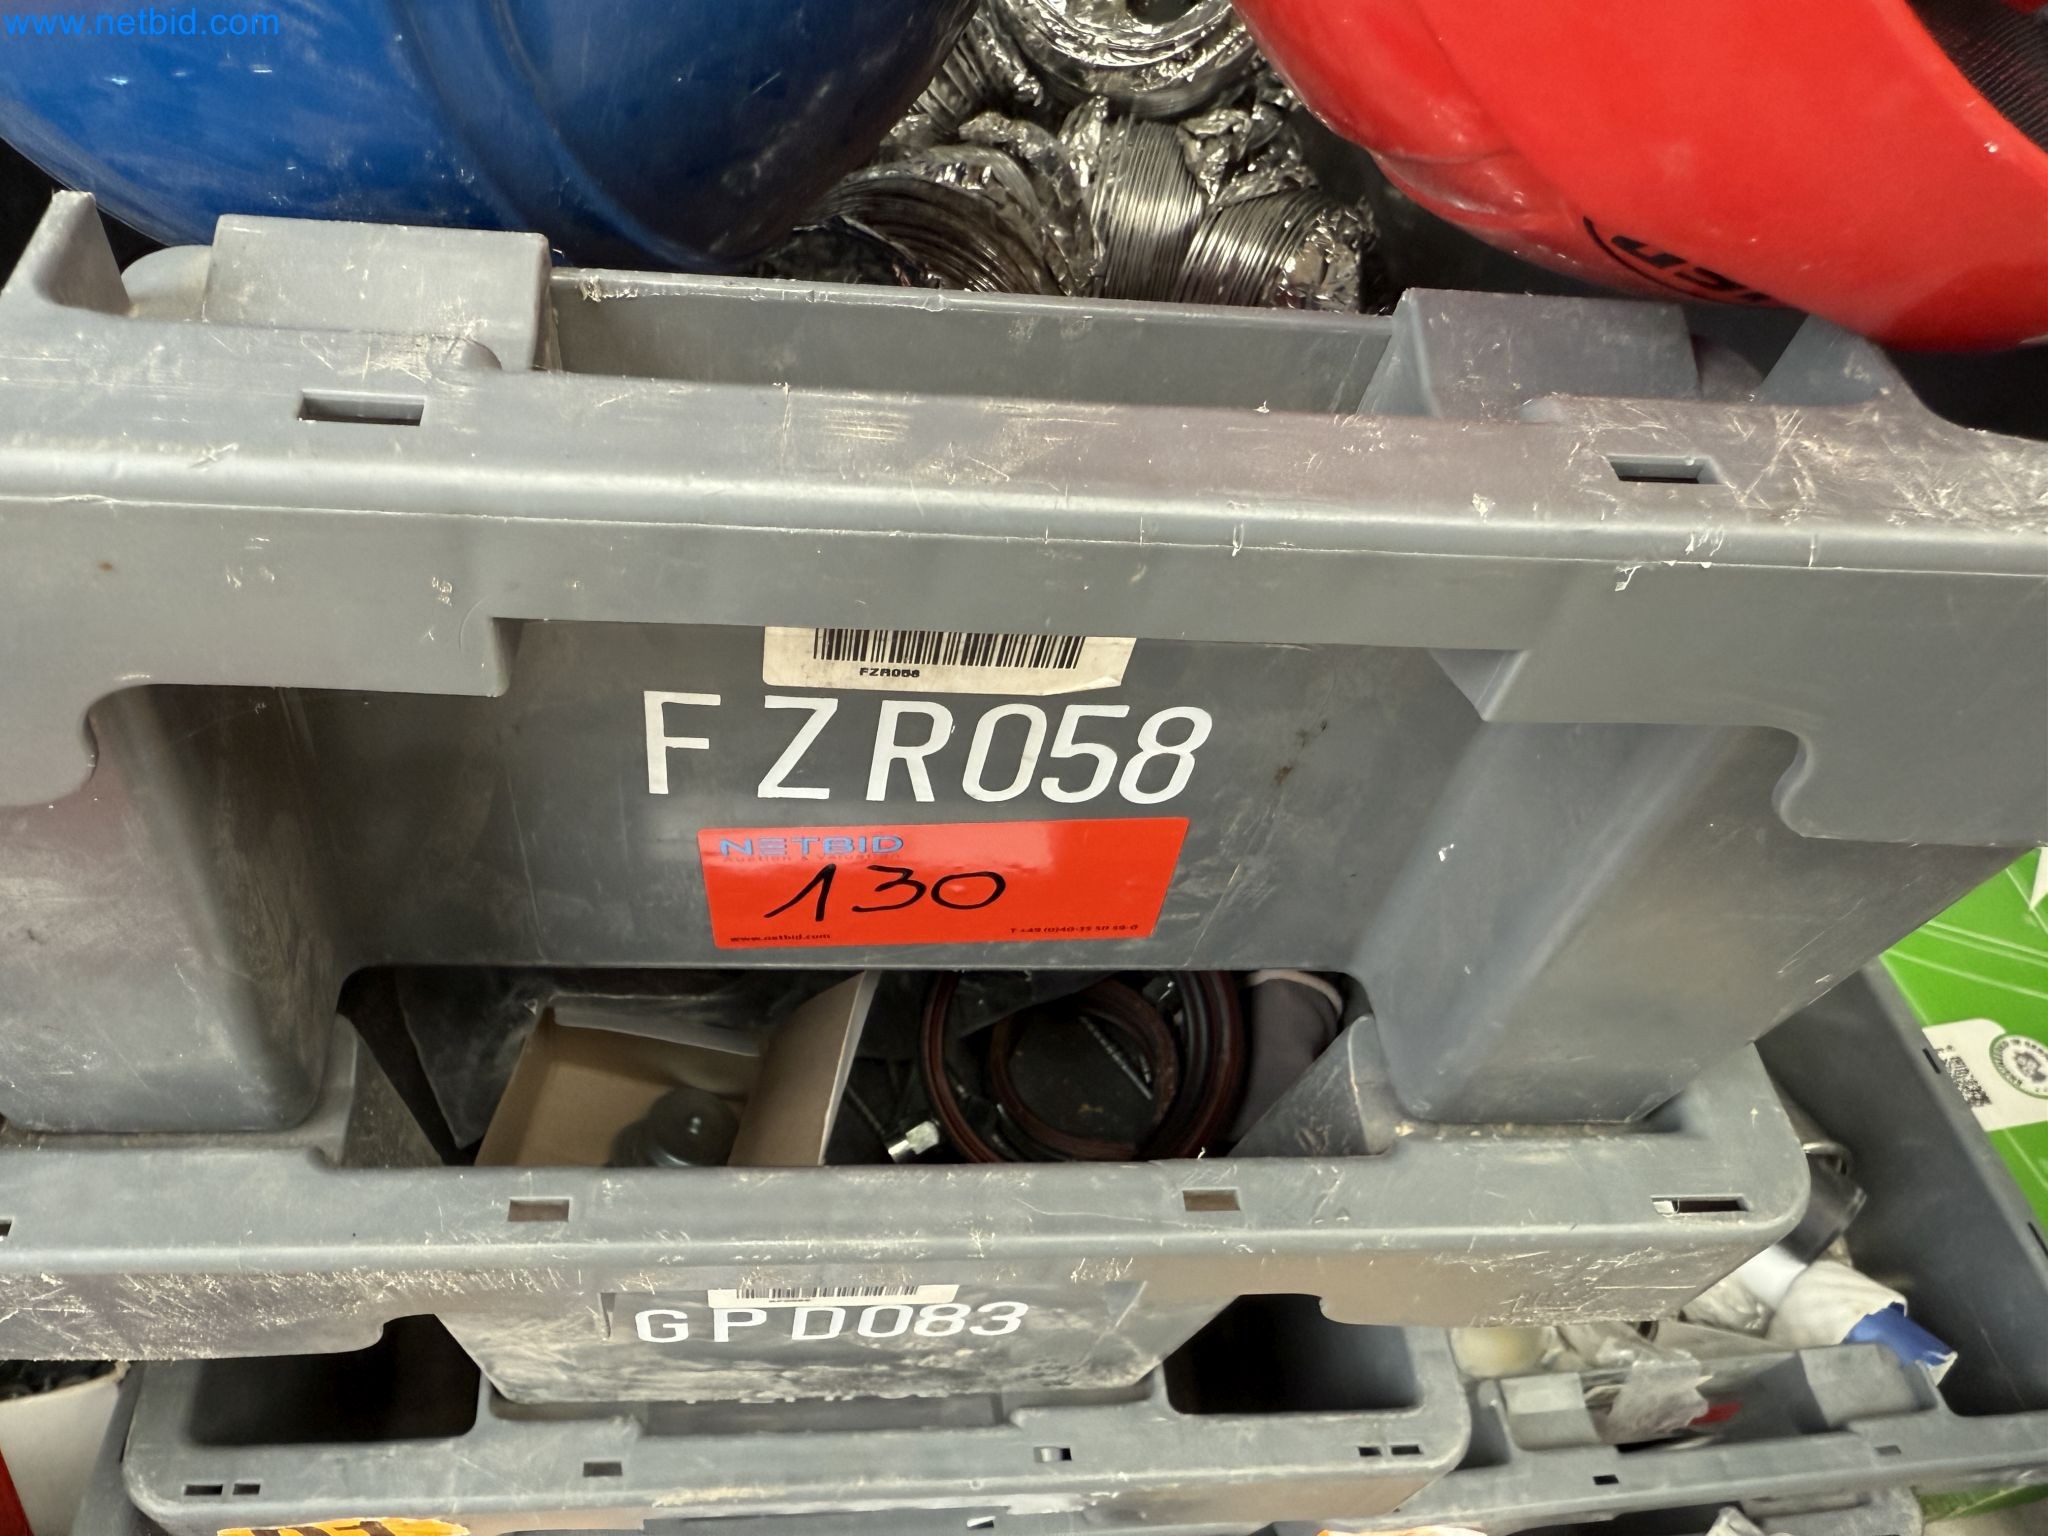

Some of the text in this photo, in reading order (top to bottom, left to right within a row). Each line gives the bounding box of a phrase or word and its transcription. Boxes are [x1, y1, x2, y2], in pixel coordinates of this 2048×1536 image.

[859, 667, 920, 678] FZR058
[719, 835, 904, 856] NETBID
[764, 863, 1006, 921] 130
[634, 1301, 1029, 1343] GPD083
